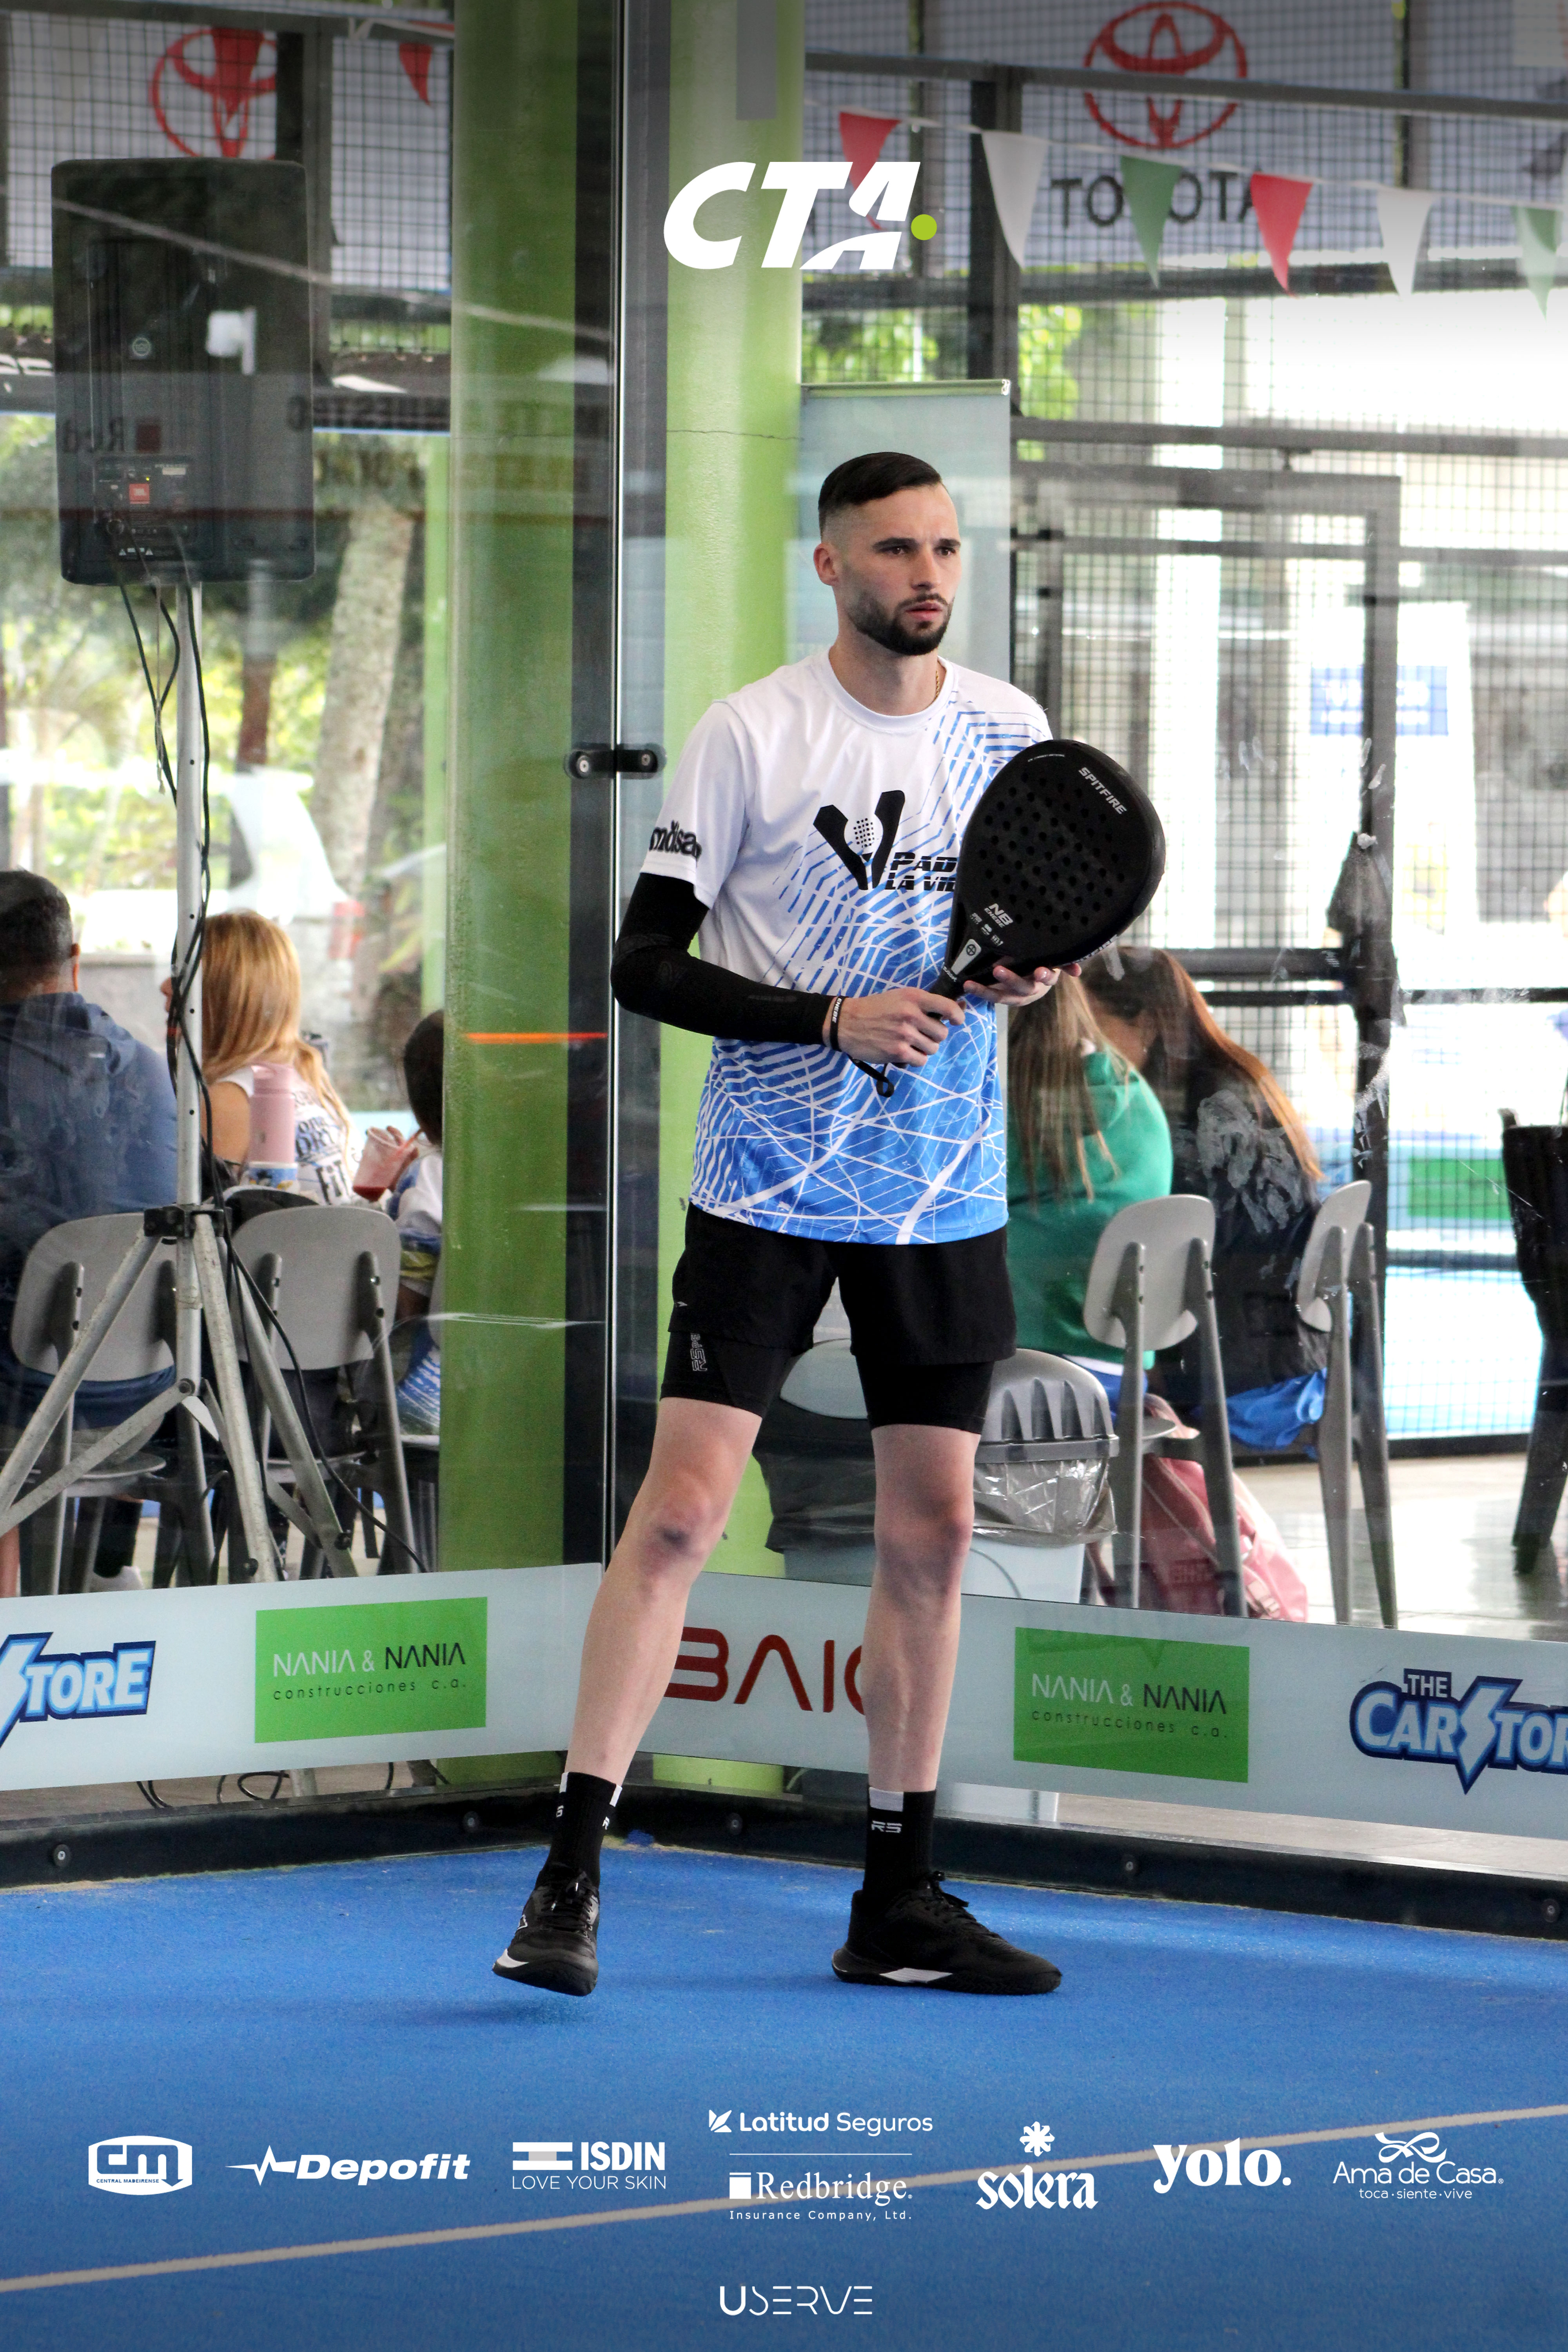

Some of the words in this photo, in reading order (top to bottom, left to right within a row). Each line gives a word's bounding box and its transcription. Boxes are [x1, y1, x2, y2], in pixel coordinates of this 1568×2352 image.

[1078, 766, 1128, 815] SPITFIRE
[885, 872, 915, 890] LA
[988, 903, 1014, 926] NB
[273, 1648, 355, 1677] NANIA
[361, 1649, 376, 1672] &
[385, 1642, 466, 1670] NANIA
[273, 1679, 416, 1701] construcciones
[432, 1678, 467, 1691] c.a.
[1032, 1673, 1114, 1704] NANIA
[1120, 1684, 1133, 1706] &
[1143, 1682, 1227, 1715] NANIA
[1406, 1673, 1449, 1698] THE
[1031, 1708, 1176, 1734] construcciones
[1191, 1724, 1229, 1739] c.a.
[871, 1820, 902, 1834] RS
